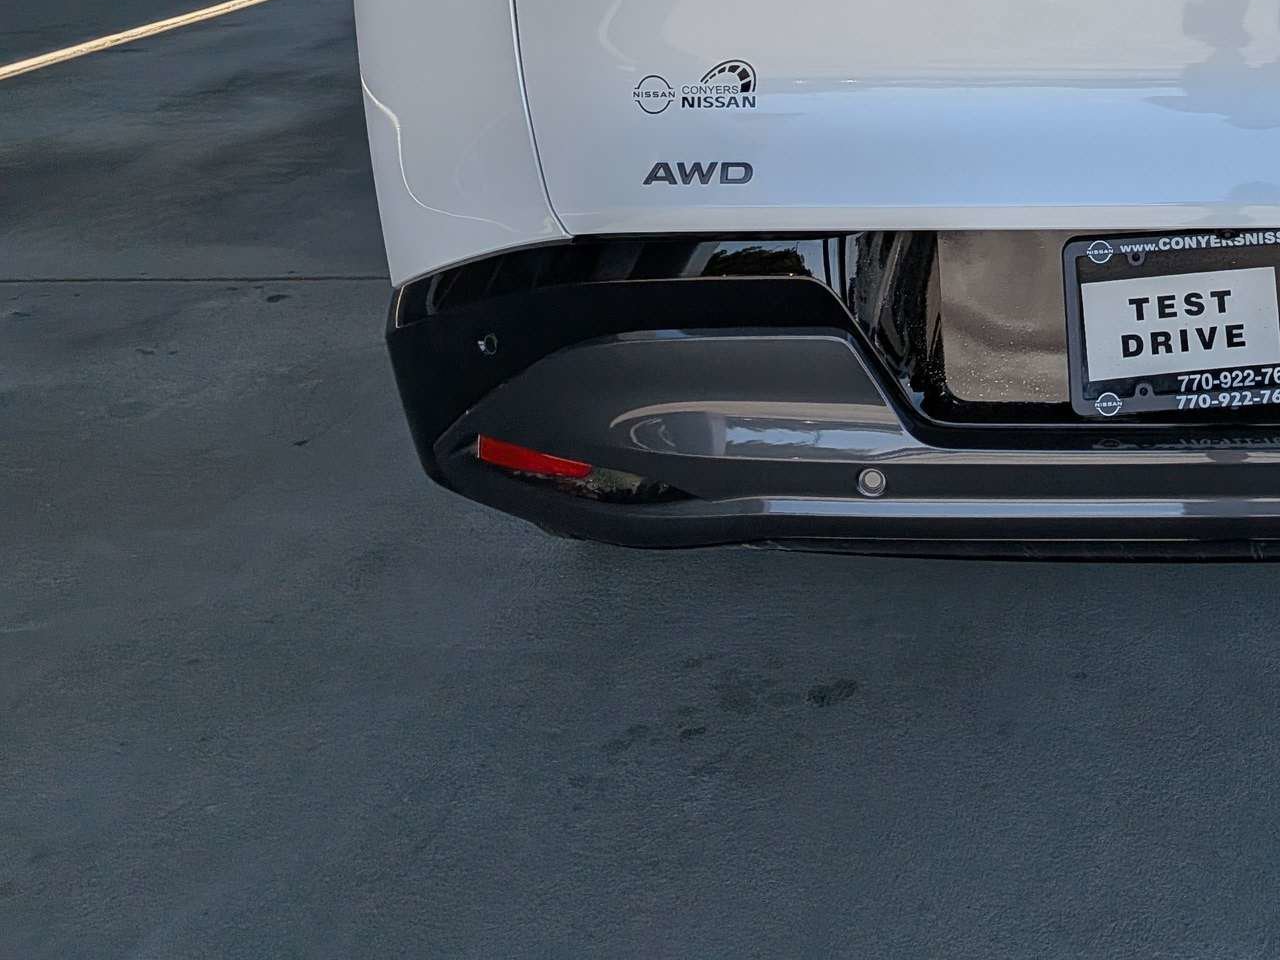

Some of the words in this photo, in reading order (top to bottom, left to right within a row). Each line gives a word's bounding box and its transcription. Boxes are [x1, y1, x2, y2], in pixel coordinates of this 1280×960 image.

[681, 85, 739, 95] CONYERS
[681, 96, 756, 109] NISSAN
[642, 161, 754, 185] AWD
[1128, 290, 1231, 321] TEST
[1121, 324, 1246, 358] DRIVE
